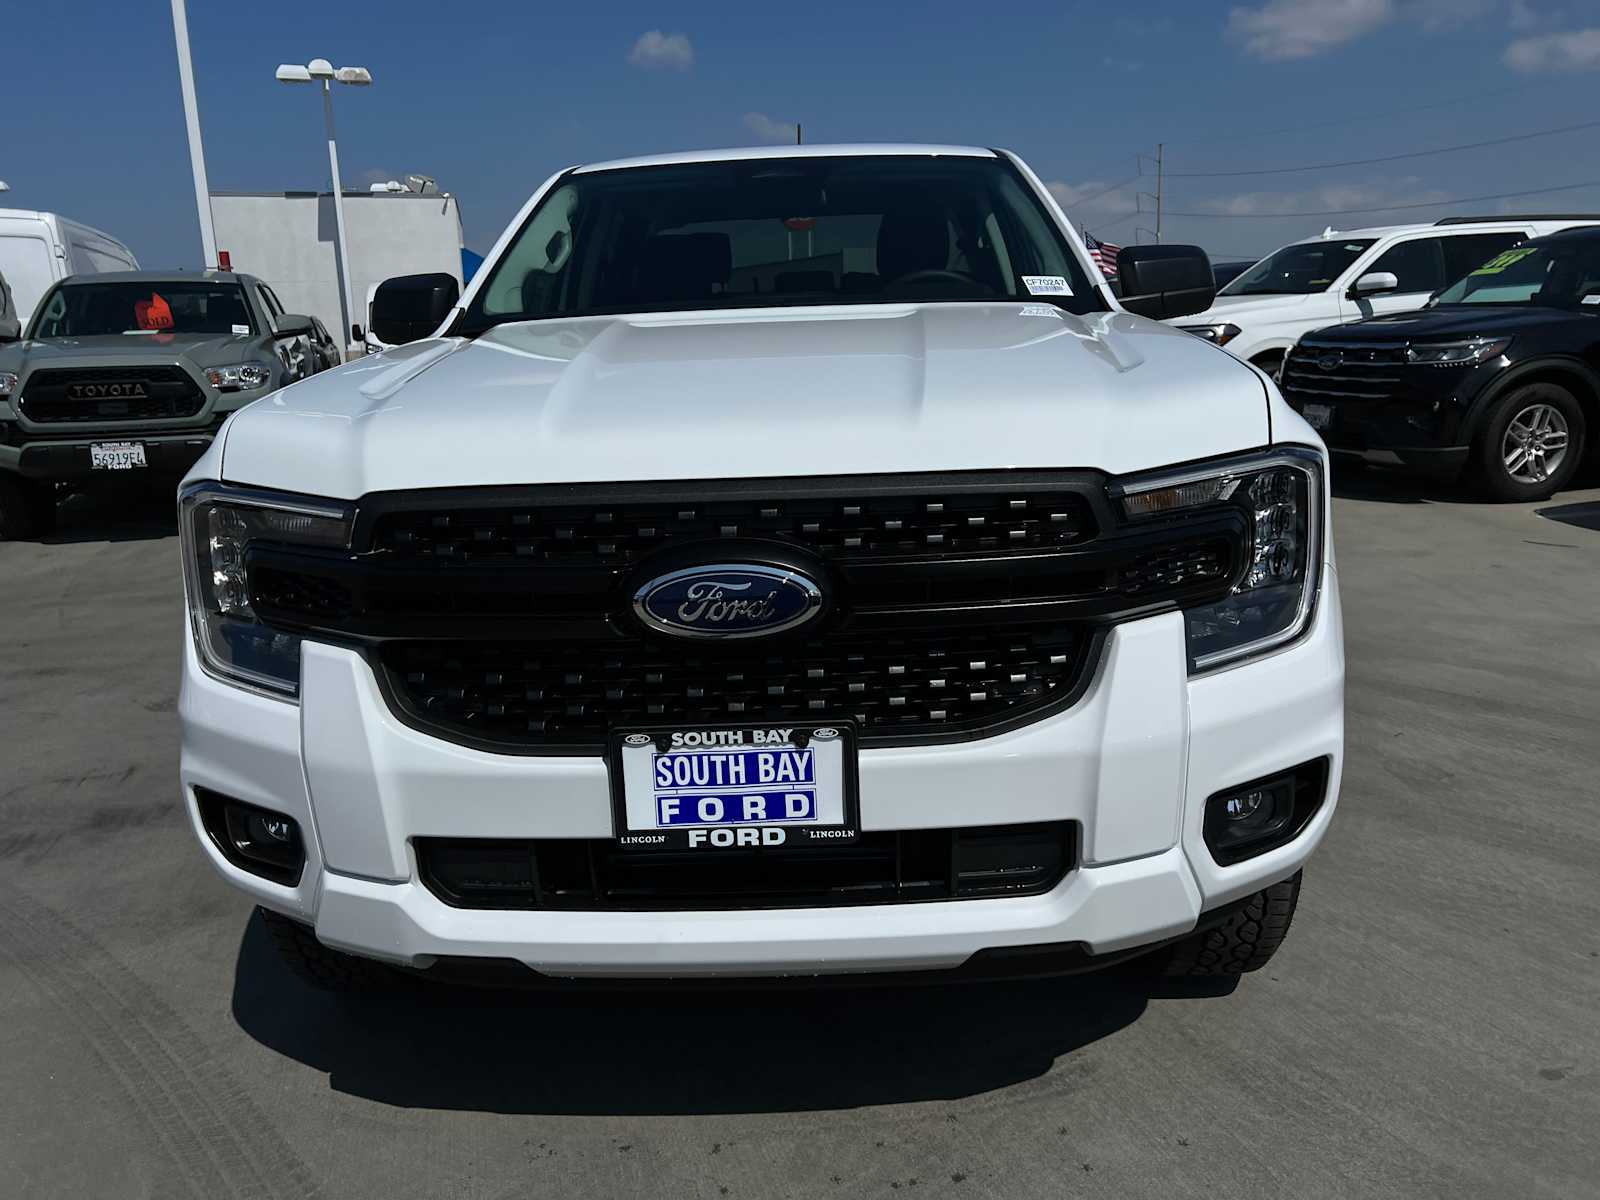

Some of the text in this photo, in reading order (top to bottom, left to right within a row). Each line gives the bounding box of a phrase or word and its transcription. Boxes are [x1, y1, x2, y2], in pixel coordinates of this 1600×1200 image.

[73, 383, 145, 396] TOYOTA
[678, 582, 777, 622] Ford
[671, 728, 793, 746] SOUTH BAY
[656, 751, 811, 787] SOUTH BAY
[621, 835, 665, 844] LINCOLN
[688, 828, 786, 848] FORD
[810, 829, 855, 839] LINCOLN
